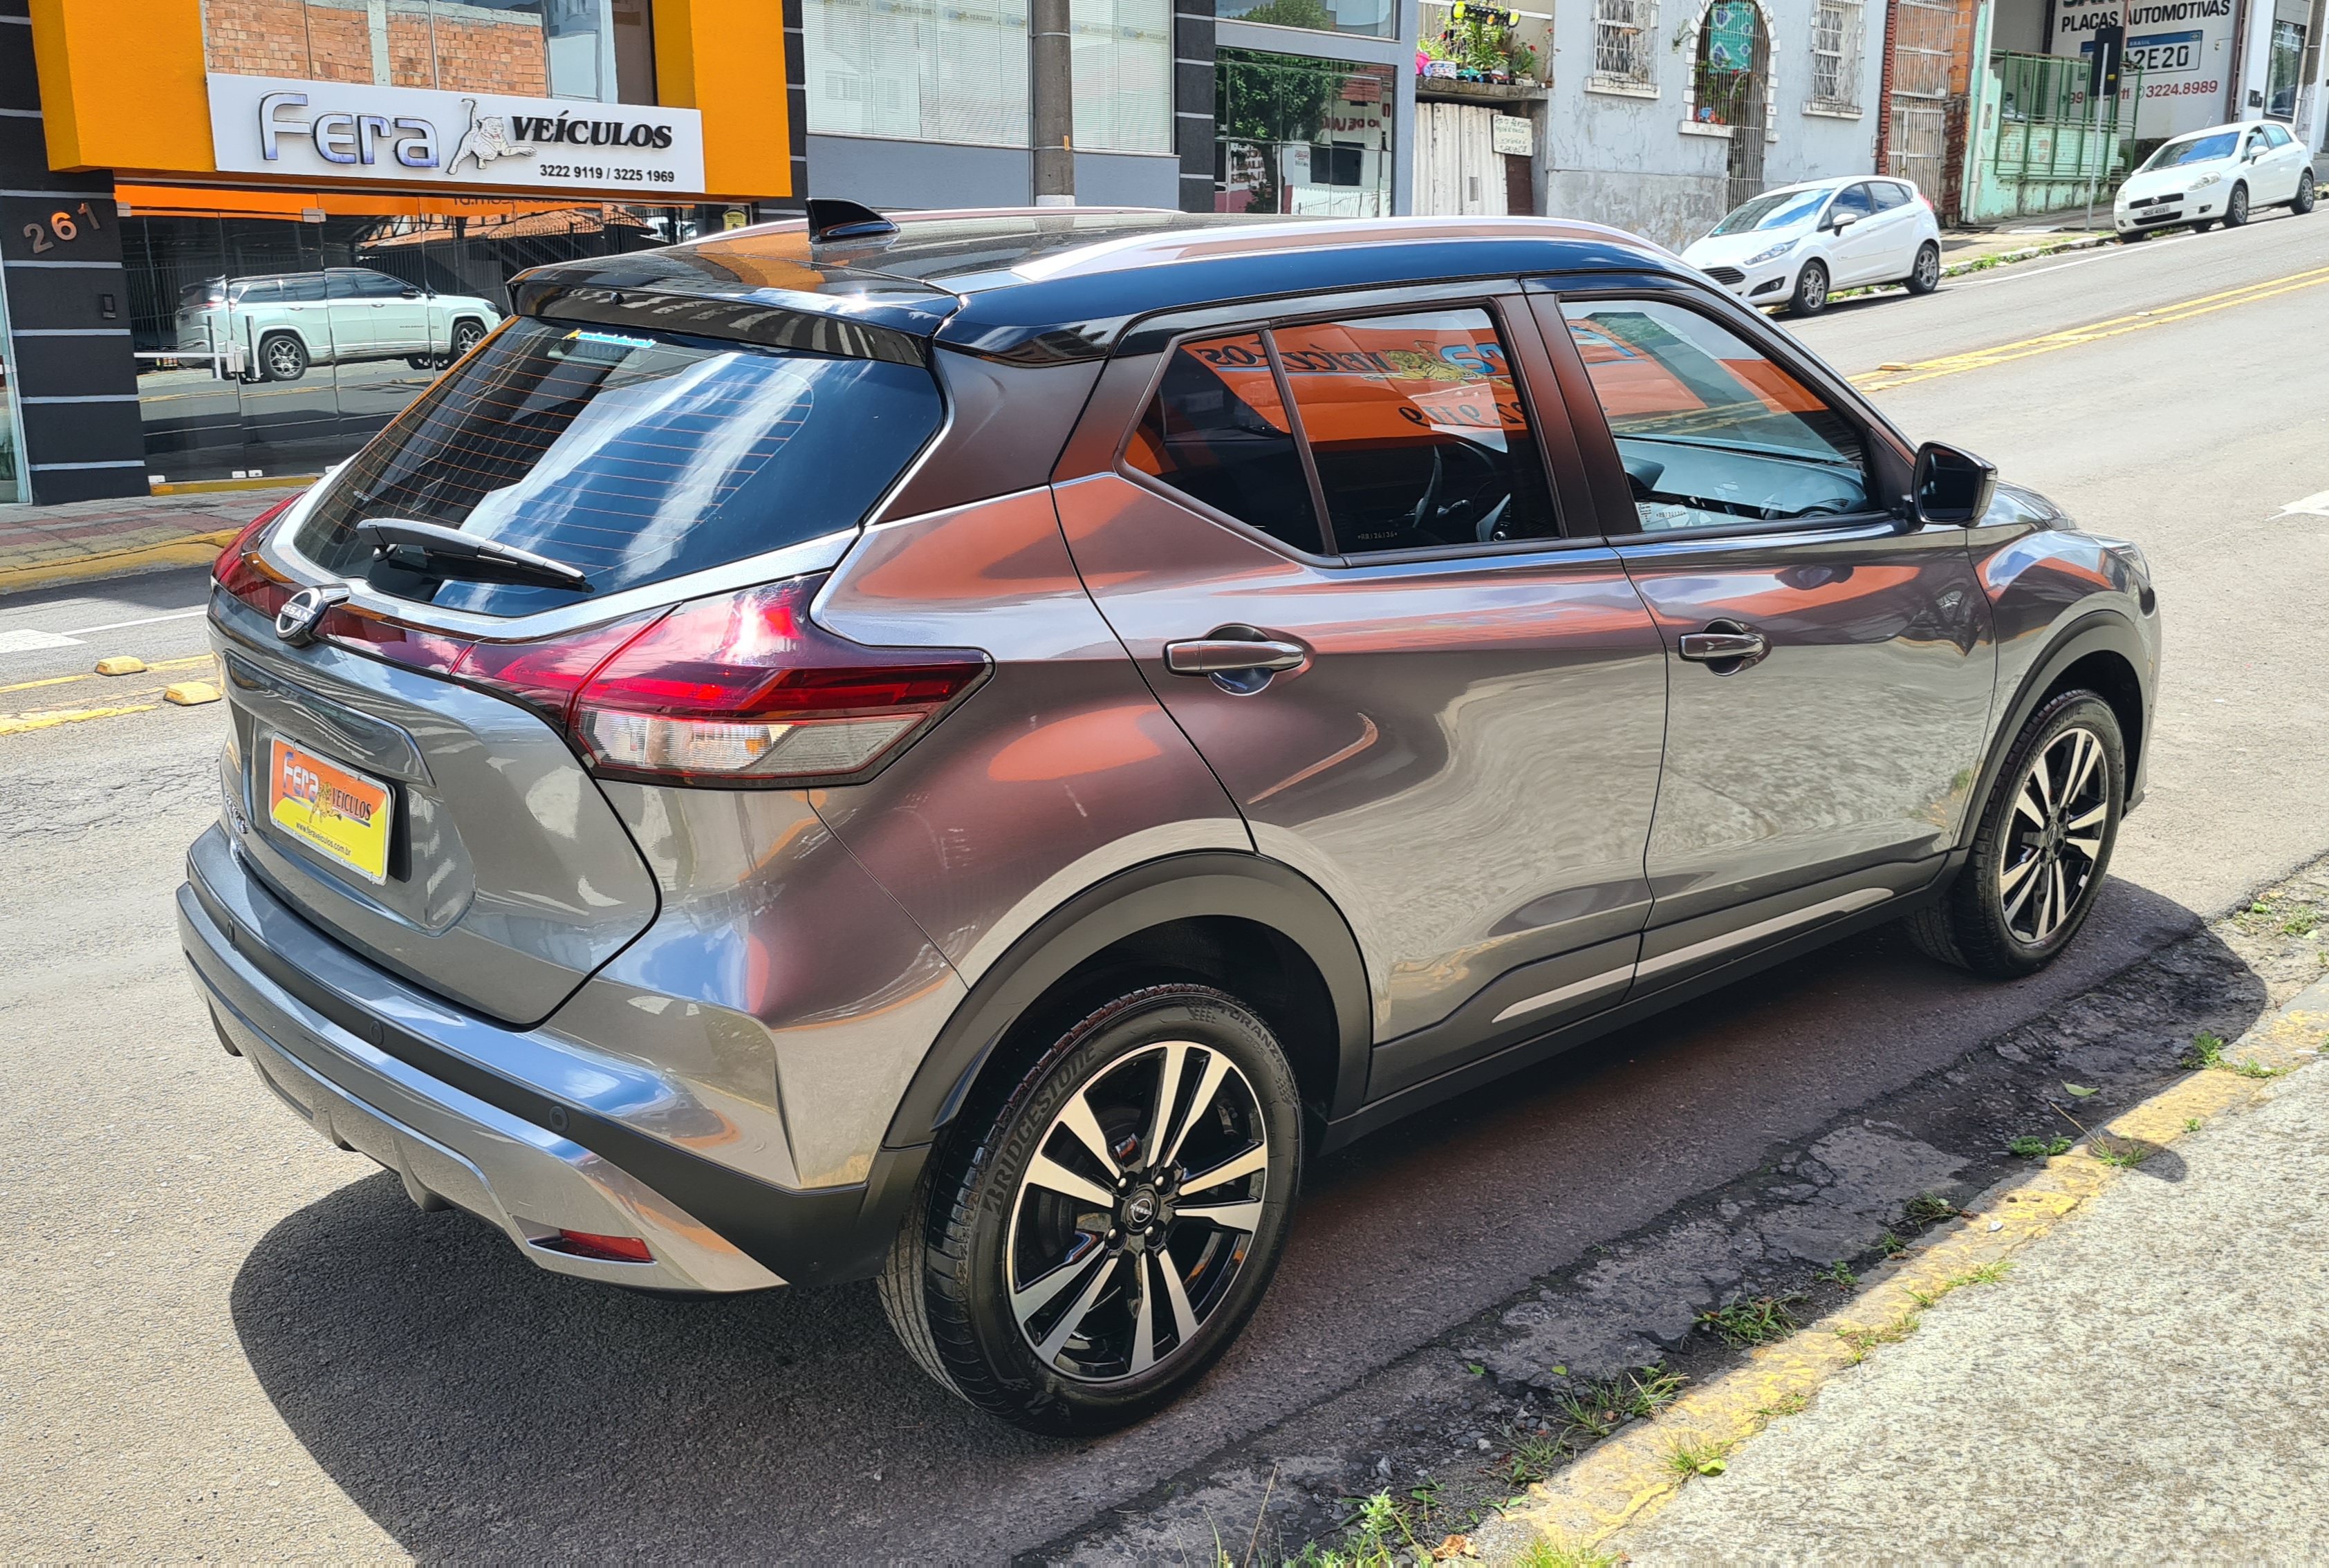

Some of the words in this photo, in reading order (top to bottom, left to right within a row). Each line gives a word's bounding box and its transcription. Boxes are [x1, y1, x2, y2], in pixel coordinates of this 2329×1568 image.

[2061, 10, 2118, 32] PLACAS
[2146, 80, 2218, 97] 3224.8989
[259, 90, 440, 167] Fera
[512, 109, 672, 149] VEÍCULOS
[540, 164, 570, 178] 3222
[574, 167, 603, 178] 9119
[613, 169, 643, 180] 3225
[647, 170, 674, 182] 1969
[24, 202, 100, 254] 261
[282, 604, 312, 622] SSAN
[283, 752, 319, 803] Fera
[332, 787, 372, 821] VEÍCULOS
[983, 1038, 1098, 1215] BRIDGESTONE
